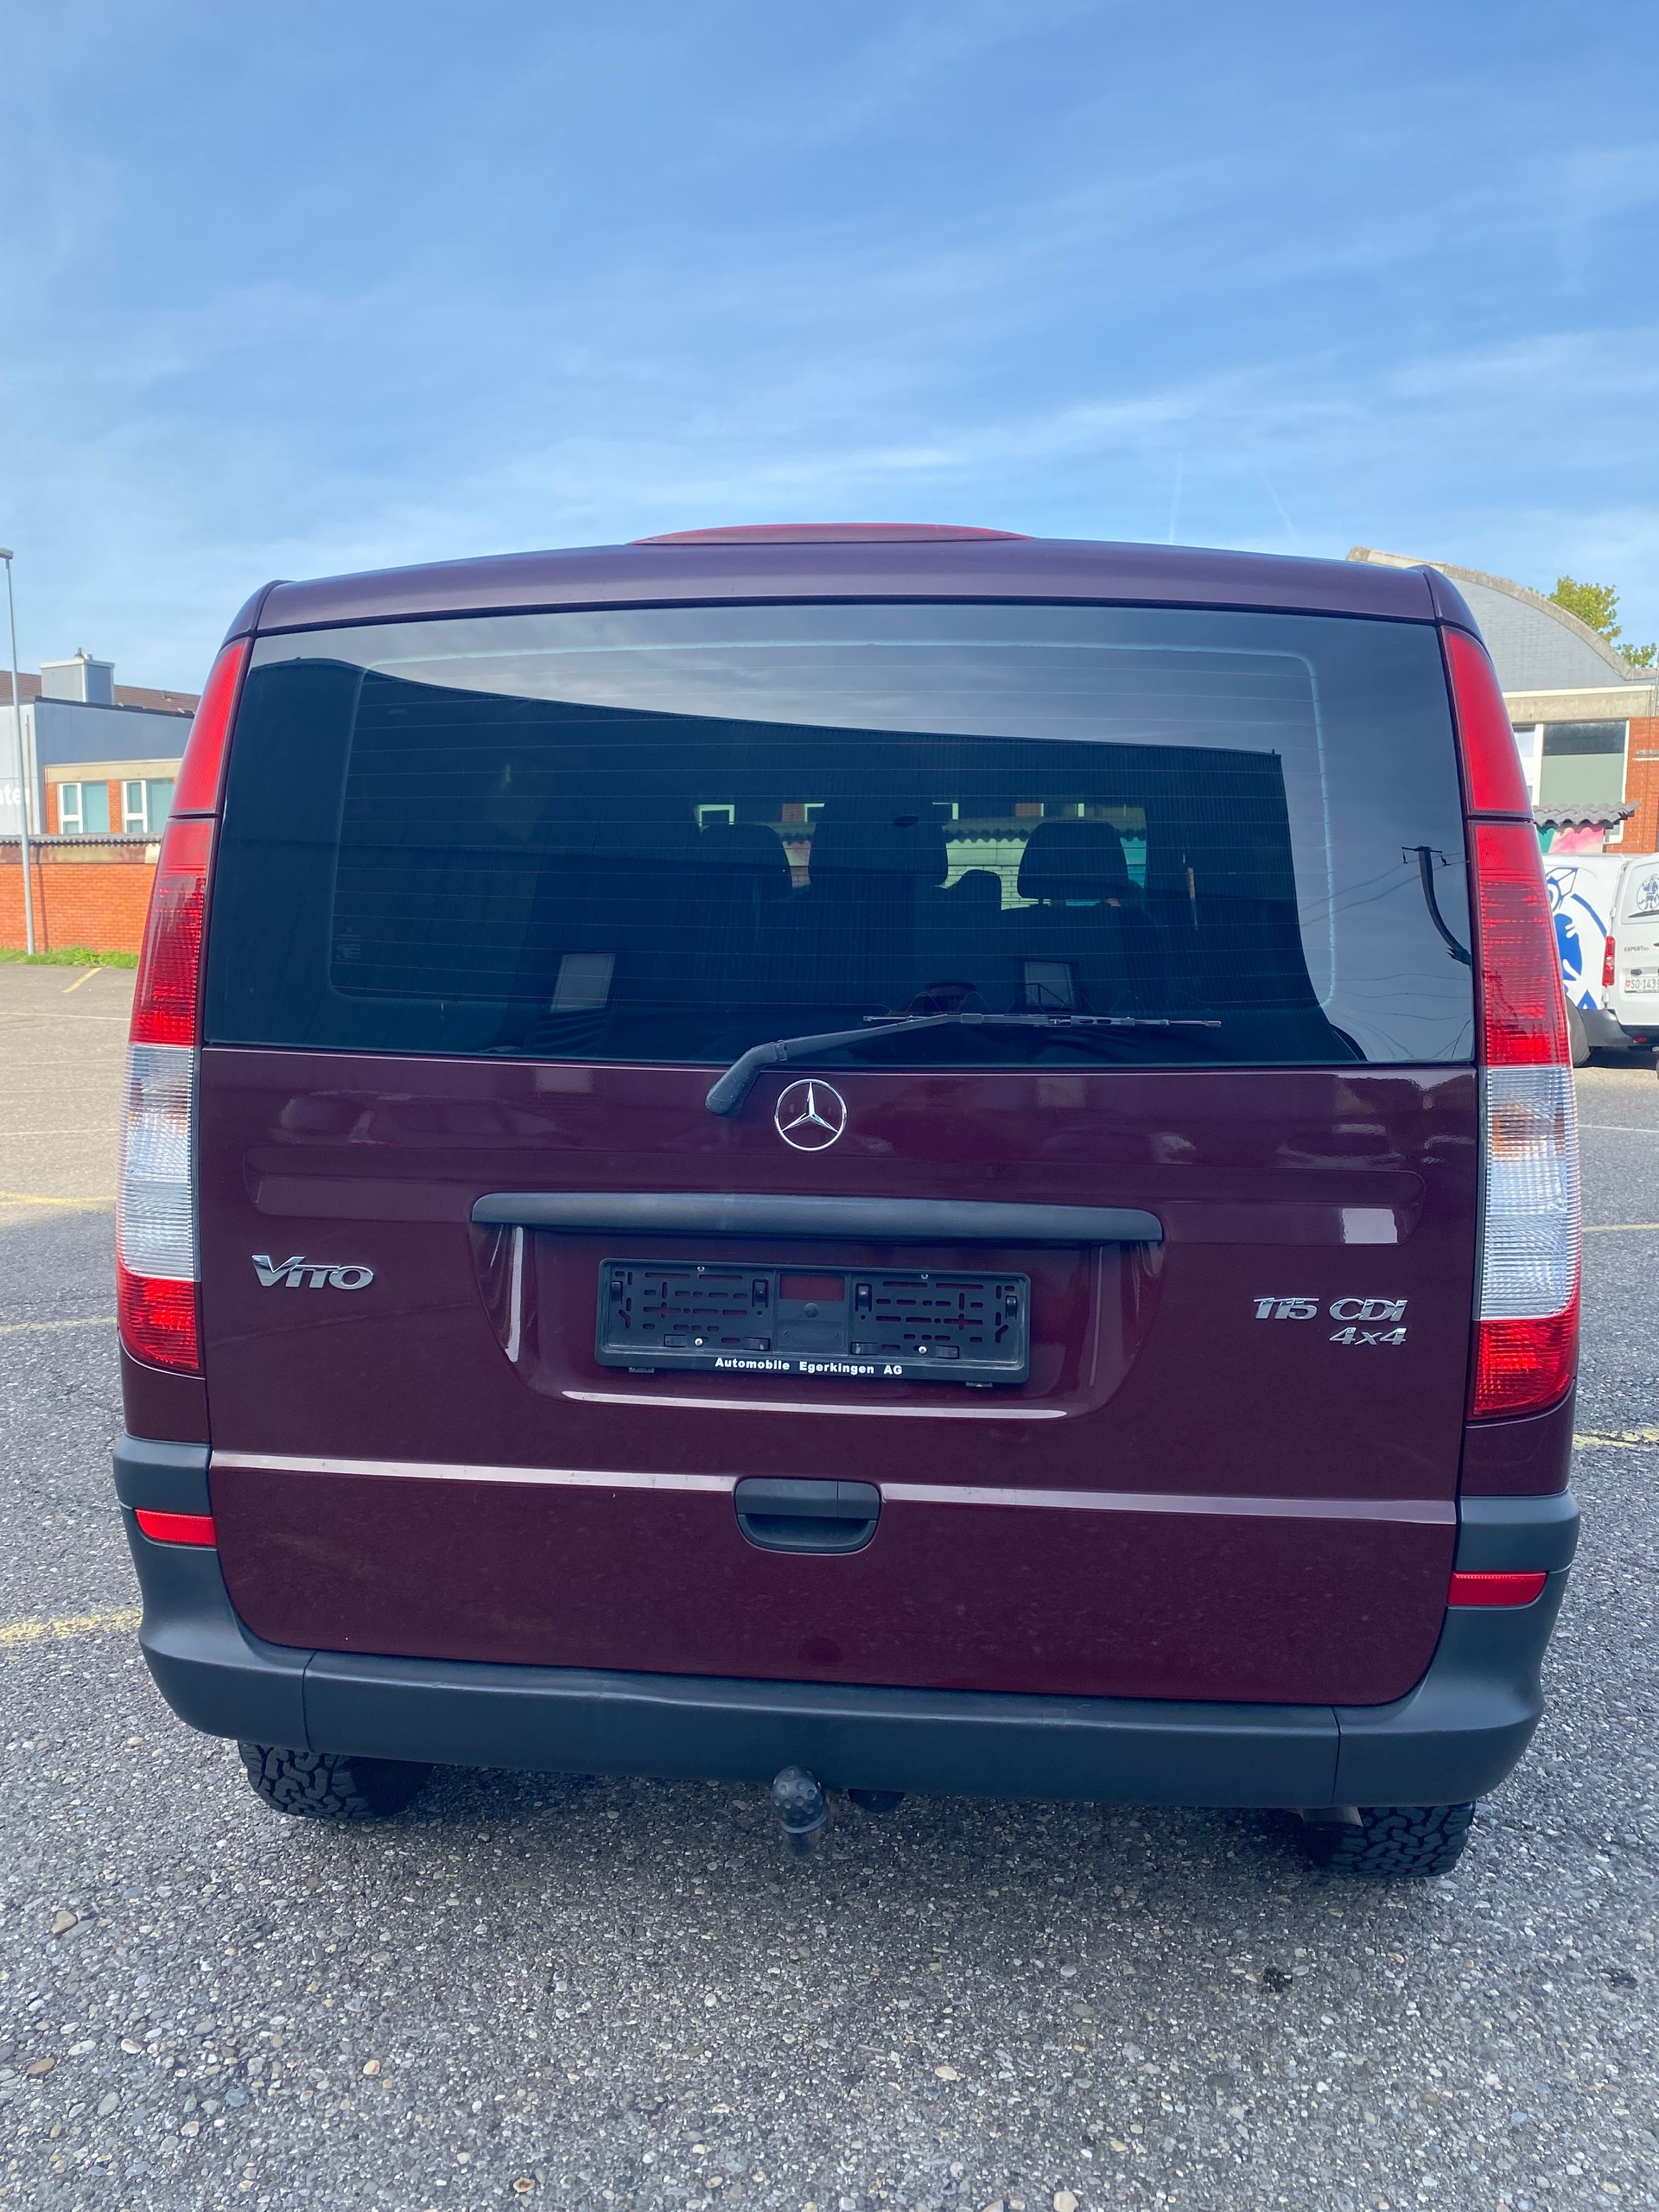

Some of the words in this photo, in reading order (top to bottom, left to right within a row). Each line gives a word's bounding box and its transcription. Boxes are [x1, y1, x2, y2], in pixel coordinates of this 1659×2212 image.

[1253, 1298, 1319, 1319] 115
[1329, 1326, 1408, 1345] 4x4
[715, 1357, 790, 1370] Automobile
[799, 1361, 874, 1375] Egerkingen
[883, 1364, 903, 1375] AG
